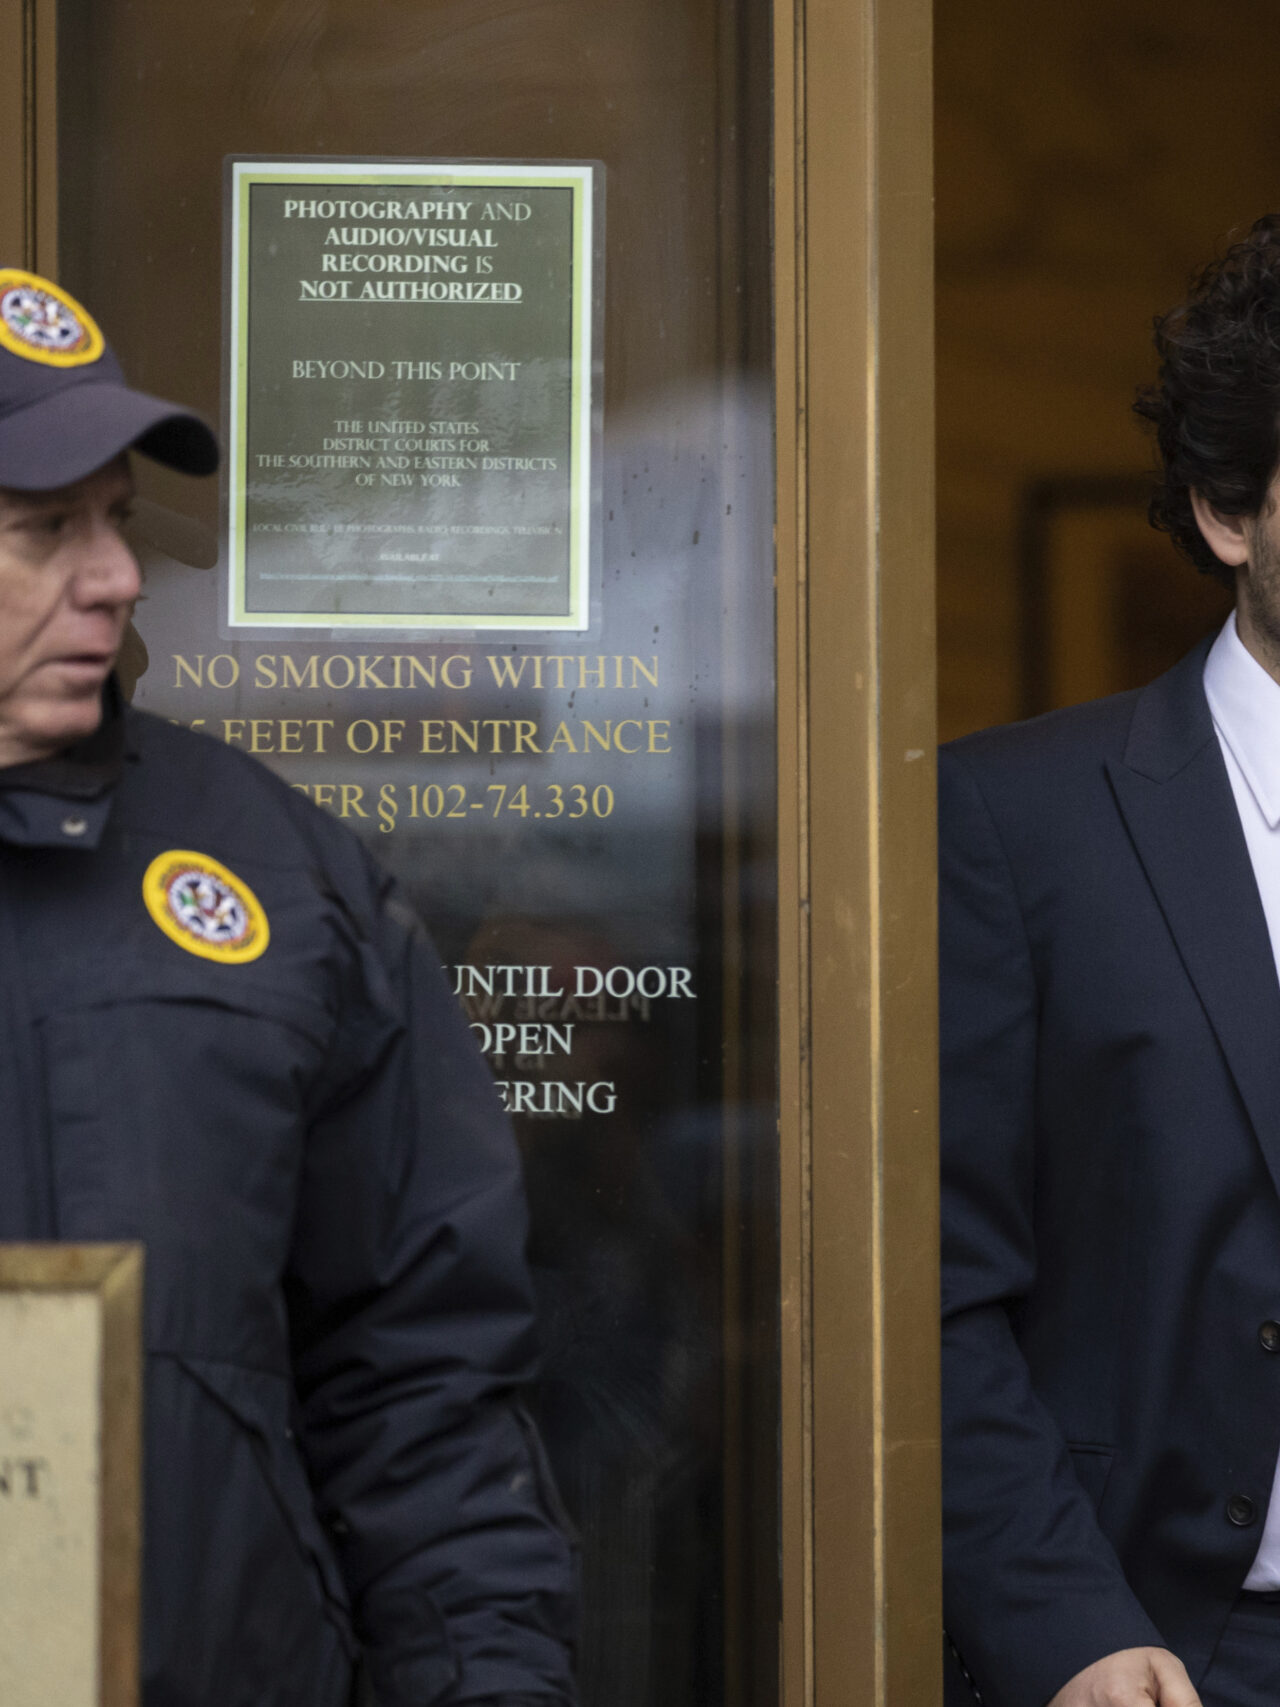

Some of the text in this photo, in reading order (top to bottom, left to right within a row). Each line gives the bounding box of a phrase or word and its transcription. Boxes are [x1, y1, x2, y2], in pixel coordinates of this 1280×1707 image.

[284, 200, 532, 222] PHOTOGRAPHY AND
[324, 227, 498, 248] AUDIO/VISUAL
[322, 253, 493, 274] RECORDING IS
[300, 280, 523, 302] NOT AUTHORIZED
[292, 360, 521, 381] BEYOND THIS POINT
[334, 420, 480, 434] THE UNITED STATES
[323, 438, 490, 452] DISTRICT COURTS FOR
[256, 454, 557, 470] THE SOUTHERN AND EASTERN DISTRICTS
[355, 473, 461, 487] OF NEW YORK
[172, 654, 659, 689] NO SMOKING WITHIN
[223, 719, 672, 754] FEET OF ENTRANCE
[290, 784, 371, 818] FR
[573, 966, 697, 998] DOOR
